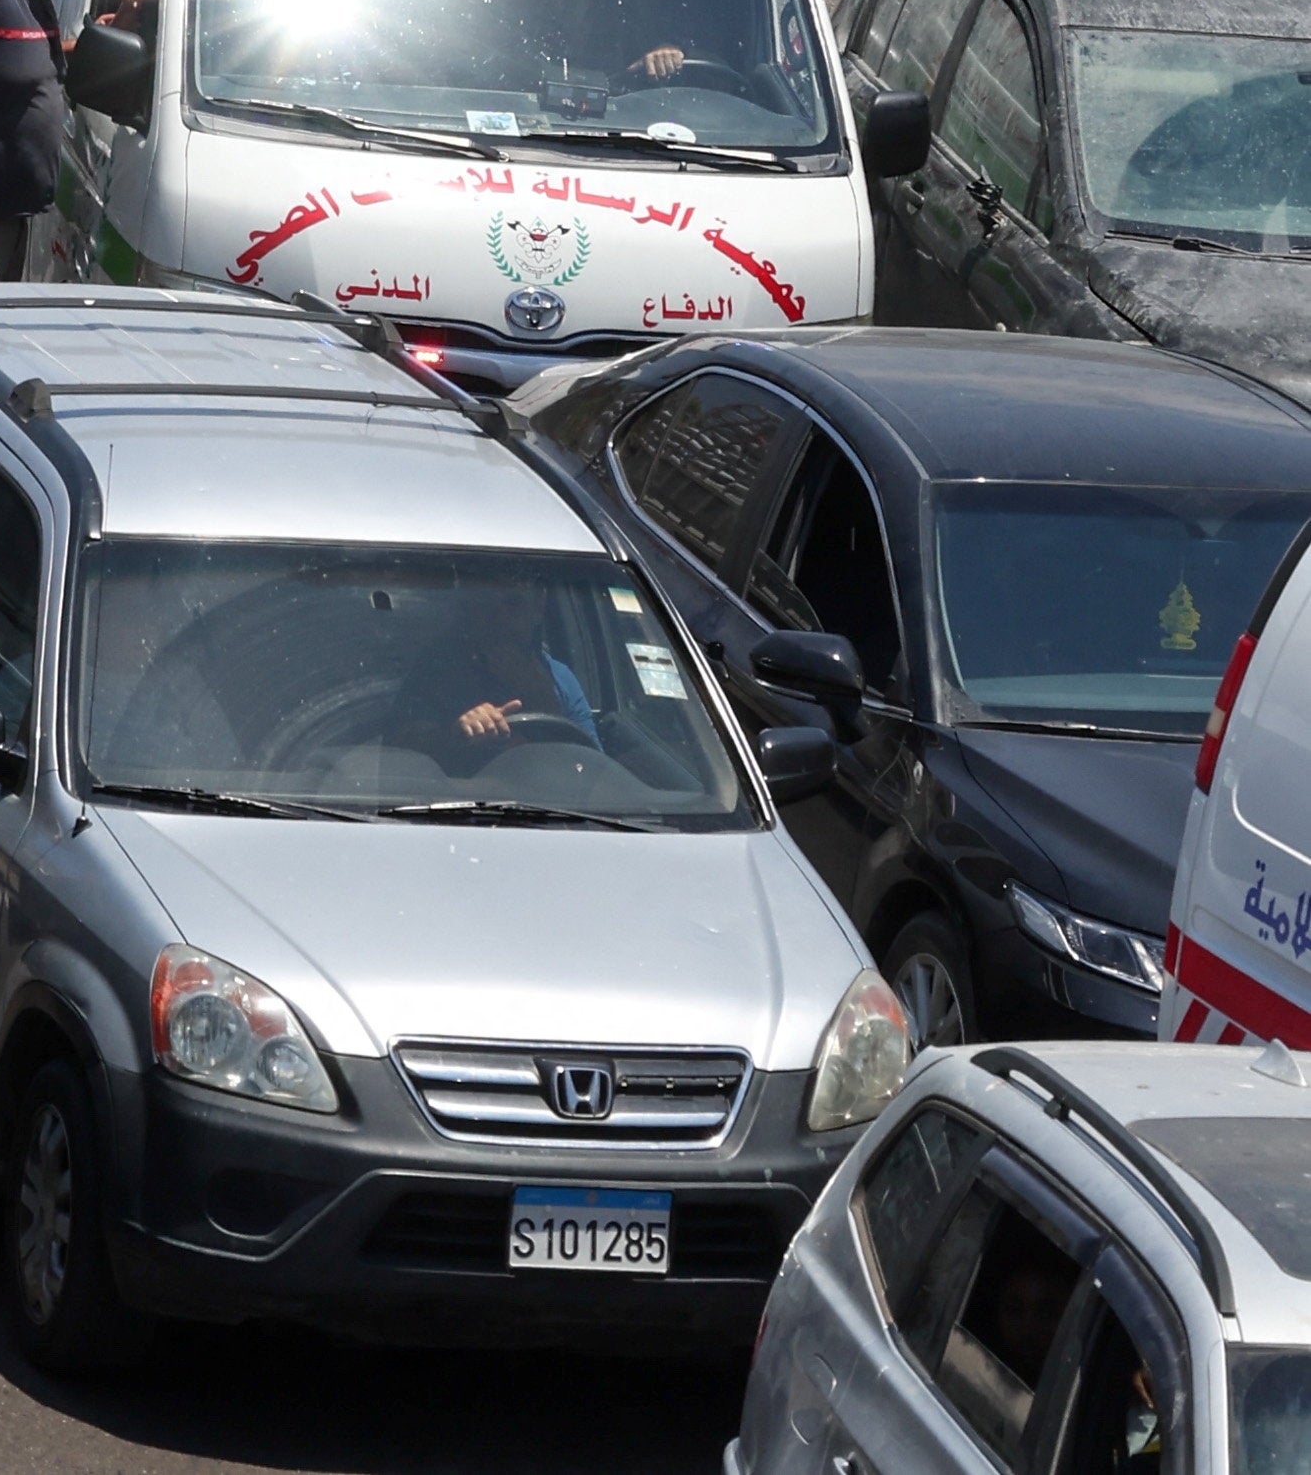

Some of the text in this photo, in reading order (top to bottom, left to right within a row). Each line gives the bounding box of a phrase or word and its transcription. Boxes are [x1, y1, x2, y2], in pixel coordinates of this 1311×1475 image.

[531, 170, 696, 233] الرسالة
[225, 184, 340, 287] الصحي
[335, 270, 734, 329] الدفاع المدني
[700, 215, 807, 325] جمعية
[512, 1217, 667, 1264] S101285
